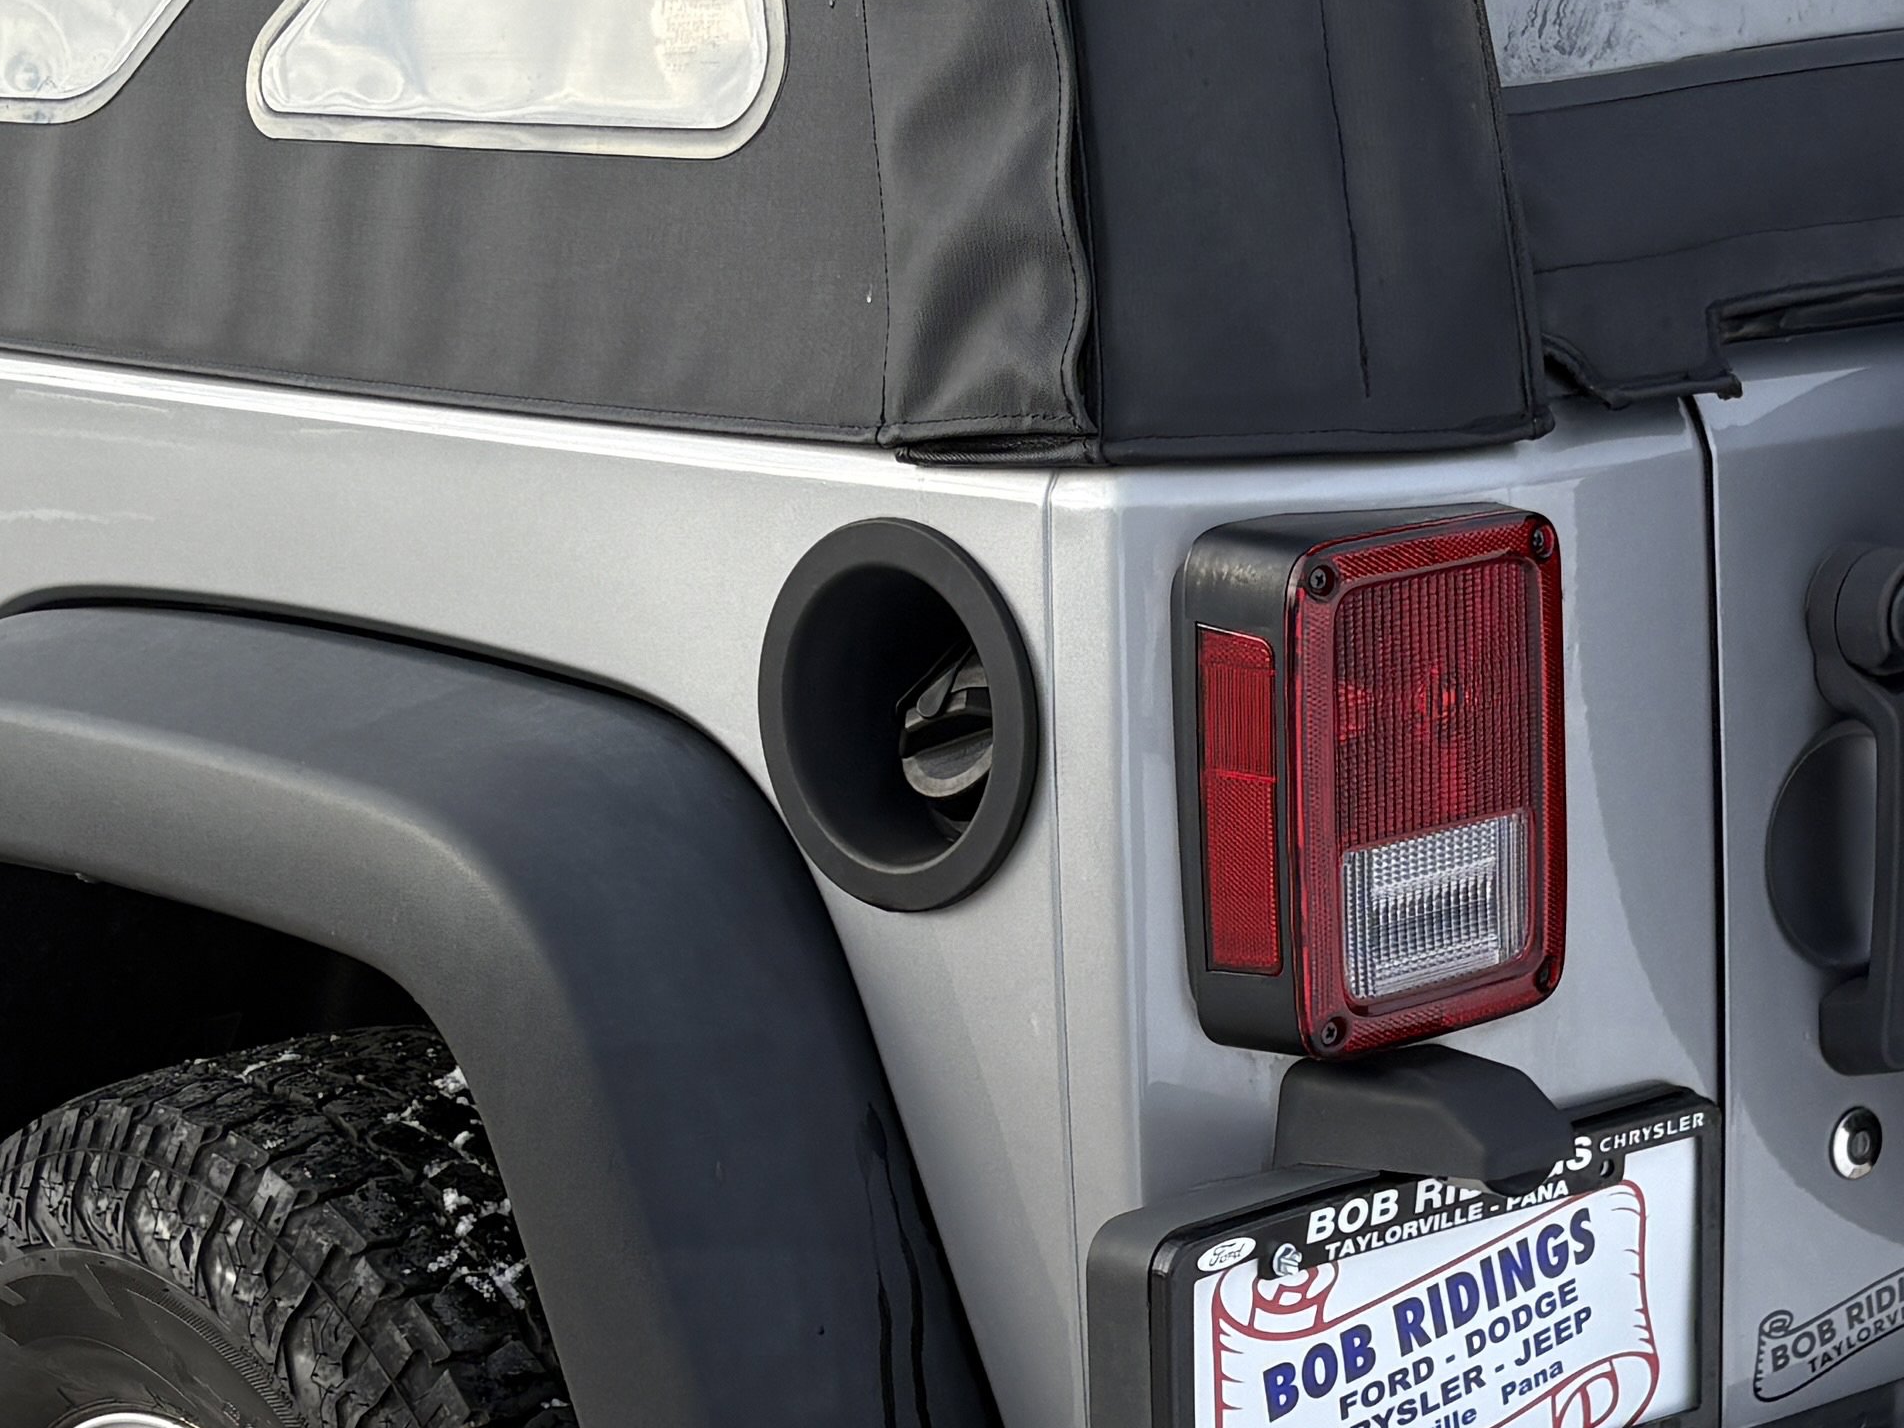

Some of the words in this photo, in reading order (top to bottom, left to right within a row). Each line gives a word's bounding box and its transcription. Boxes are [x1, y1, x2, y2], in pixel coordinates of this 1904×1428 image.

[1599, 1111, 1705, 1153] CHRYSLER
[1306, 1188, 1399, 1245] BOB
[1325, 1201, 1484, 1262] TAYLORVILLE
[1506, 1179, 1569, 1212] PANA
[1208, 1242, 1246, 1267] Ford
[1262, 1323, 1376, 1423] BOB
[1392, 1207, 1596, 1357] RIDINGS
[1514, 1305, 1593, 1368] JEEP
[1339, 1355, 1435, 1421] FORD
[1464, 1278, 1579, 1358] DODGE
[1770, 1318, 1838, 1373] BOB
[1500, 1359, 1564, 1406] Pana
